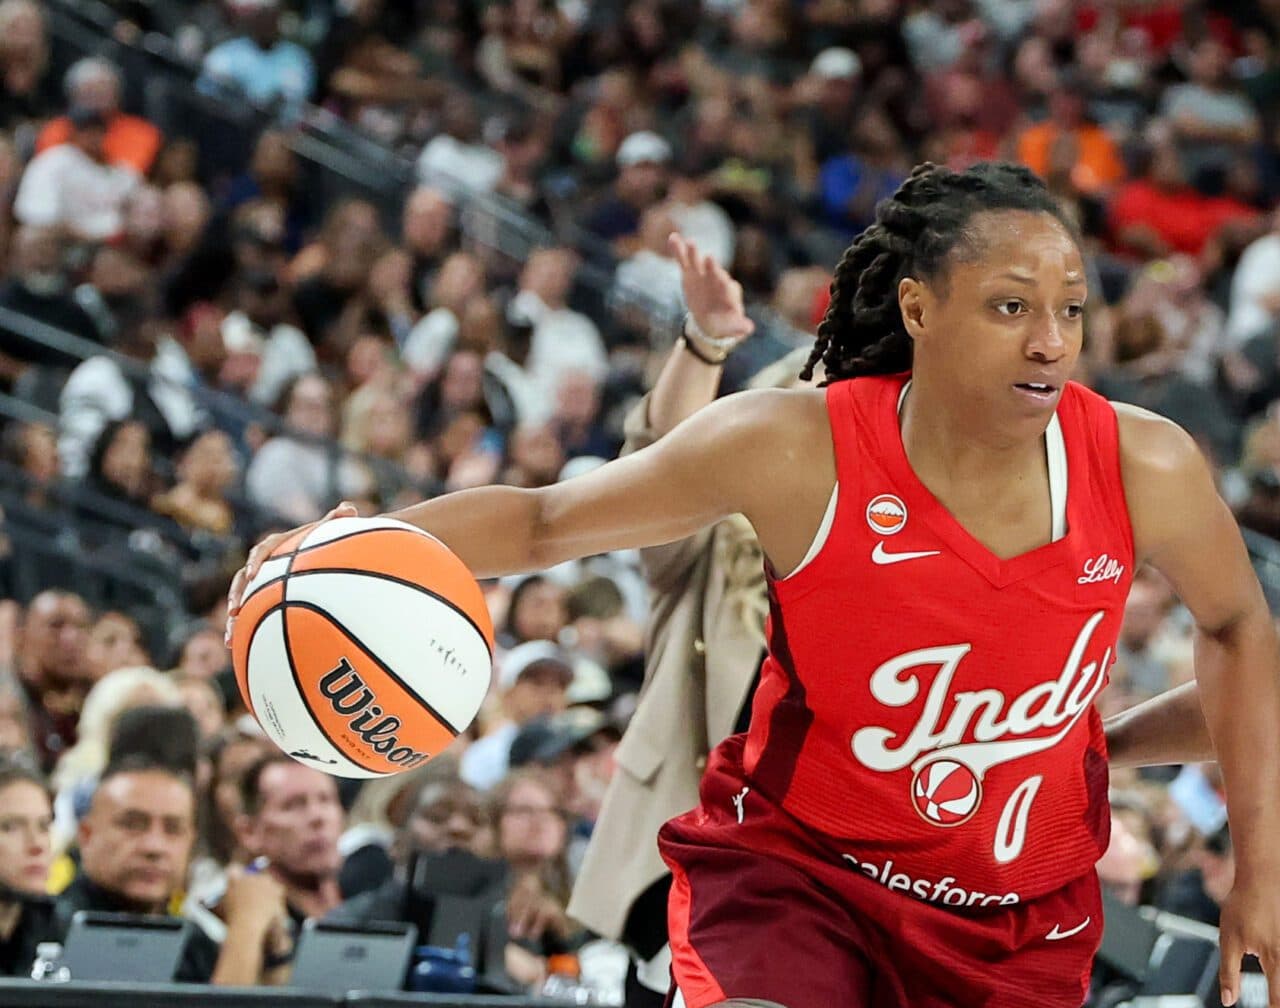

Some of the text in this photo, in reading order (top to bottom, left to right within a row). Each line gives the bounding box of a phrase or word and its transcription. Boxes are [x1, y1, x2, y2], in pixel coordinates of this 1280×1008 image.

[1077, 553, 1124, 585] Lilly
[318, 655, 430, 769] Wilson
[850, 610, 1112, 773] Indy
[992, 775, 1043, 863] 0
